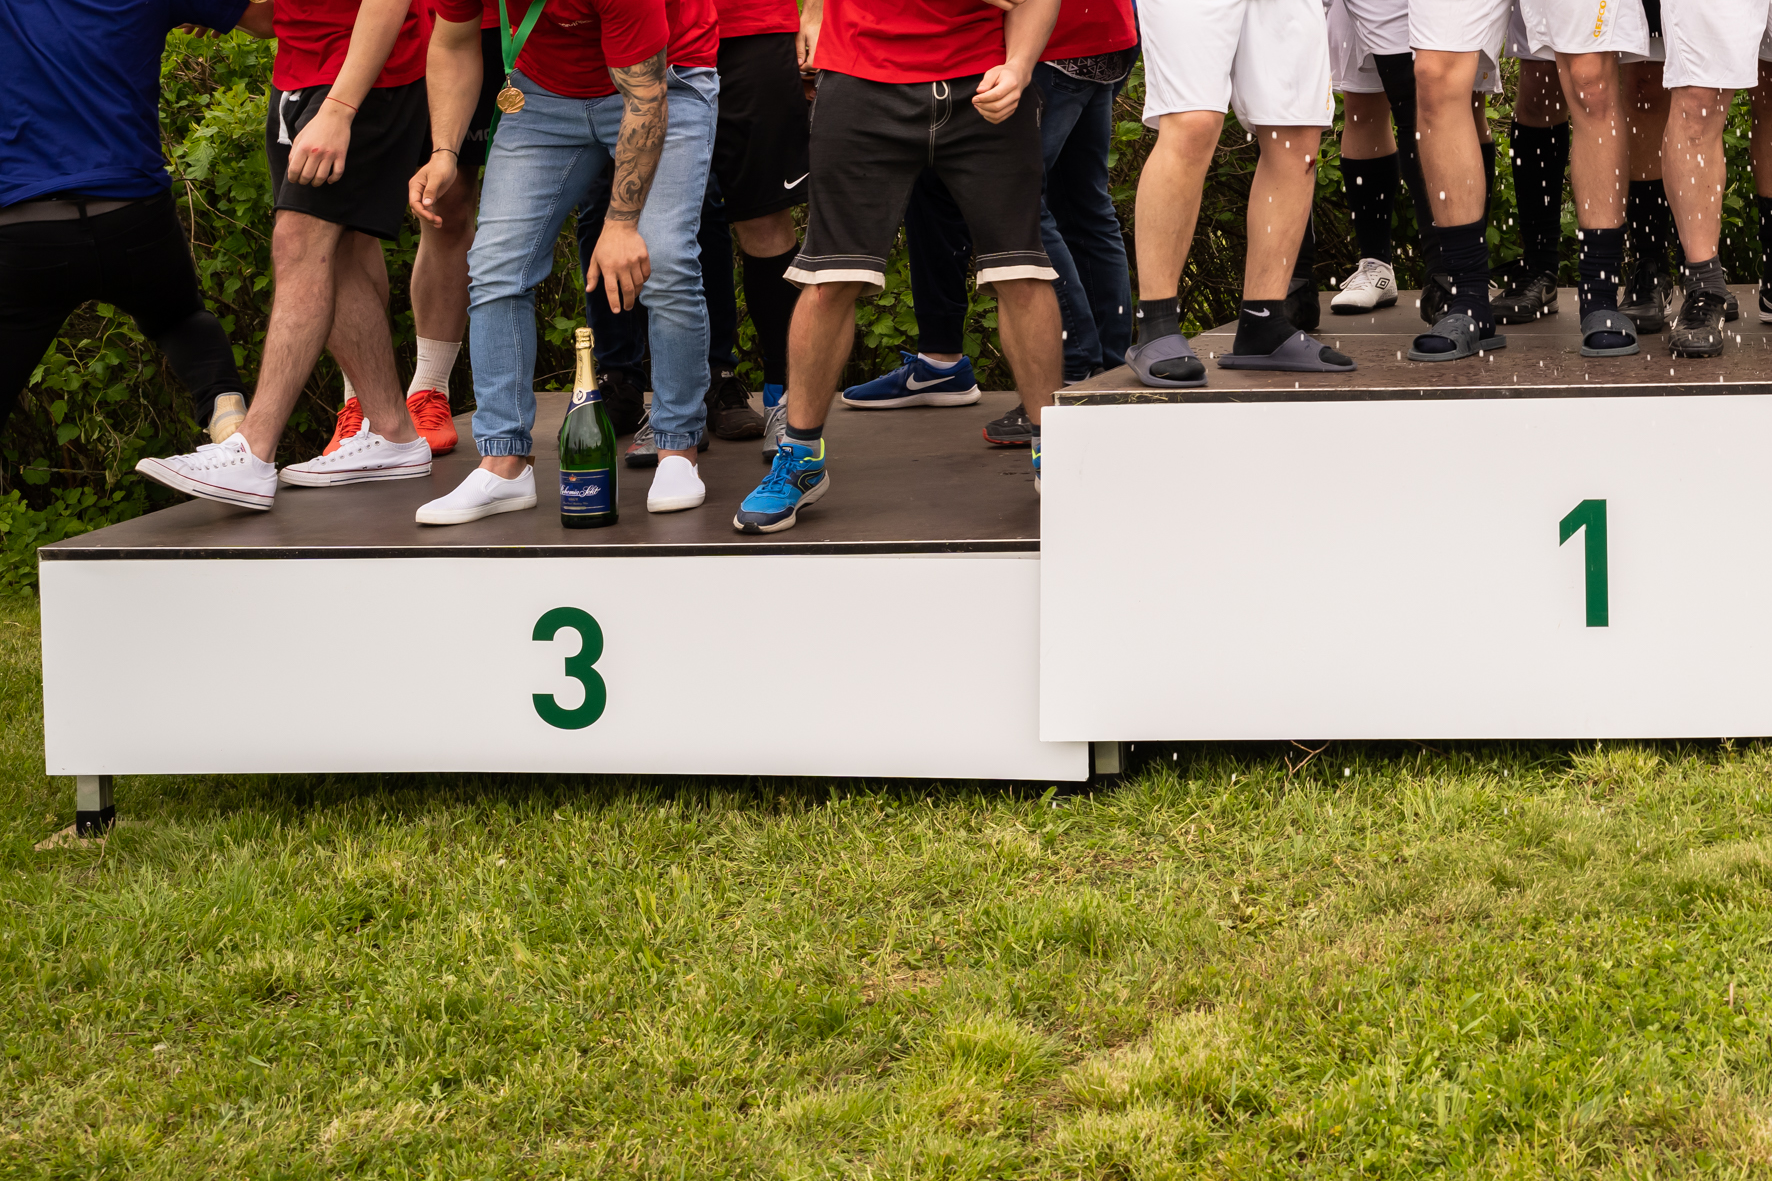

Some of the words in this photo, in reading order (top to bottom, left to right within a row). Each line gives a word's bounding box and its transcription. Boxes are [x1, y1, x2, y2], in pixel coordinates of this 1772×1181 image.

[1593, 0, 1607, 38] GEFCO
[1560, 500, 1609, 627] 1
[533, 607, 607, 729] 3
